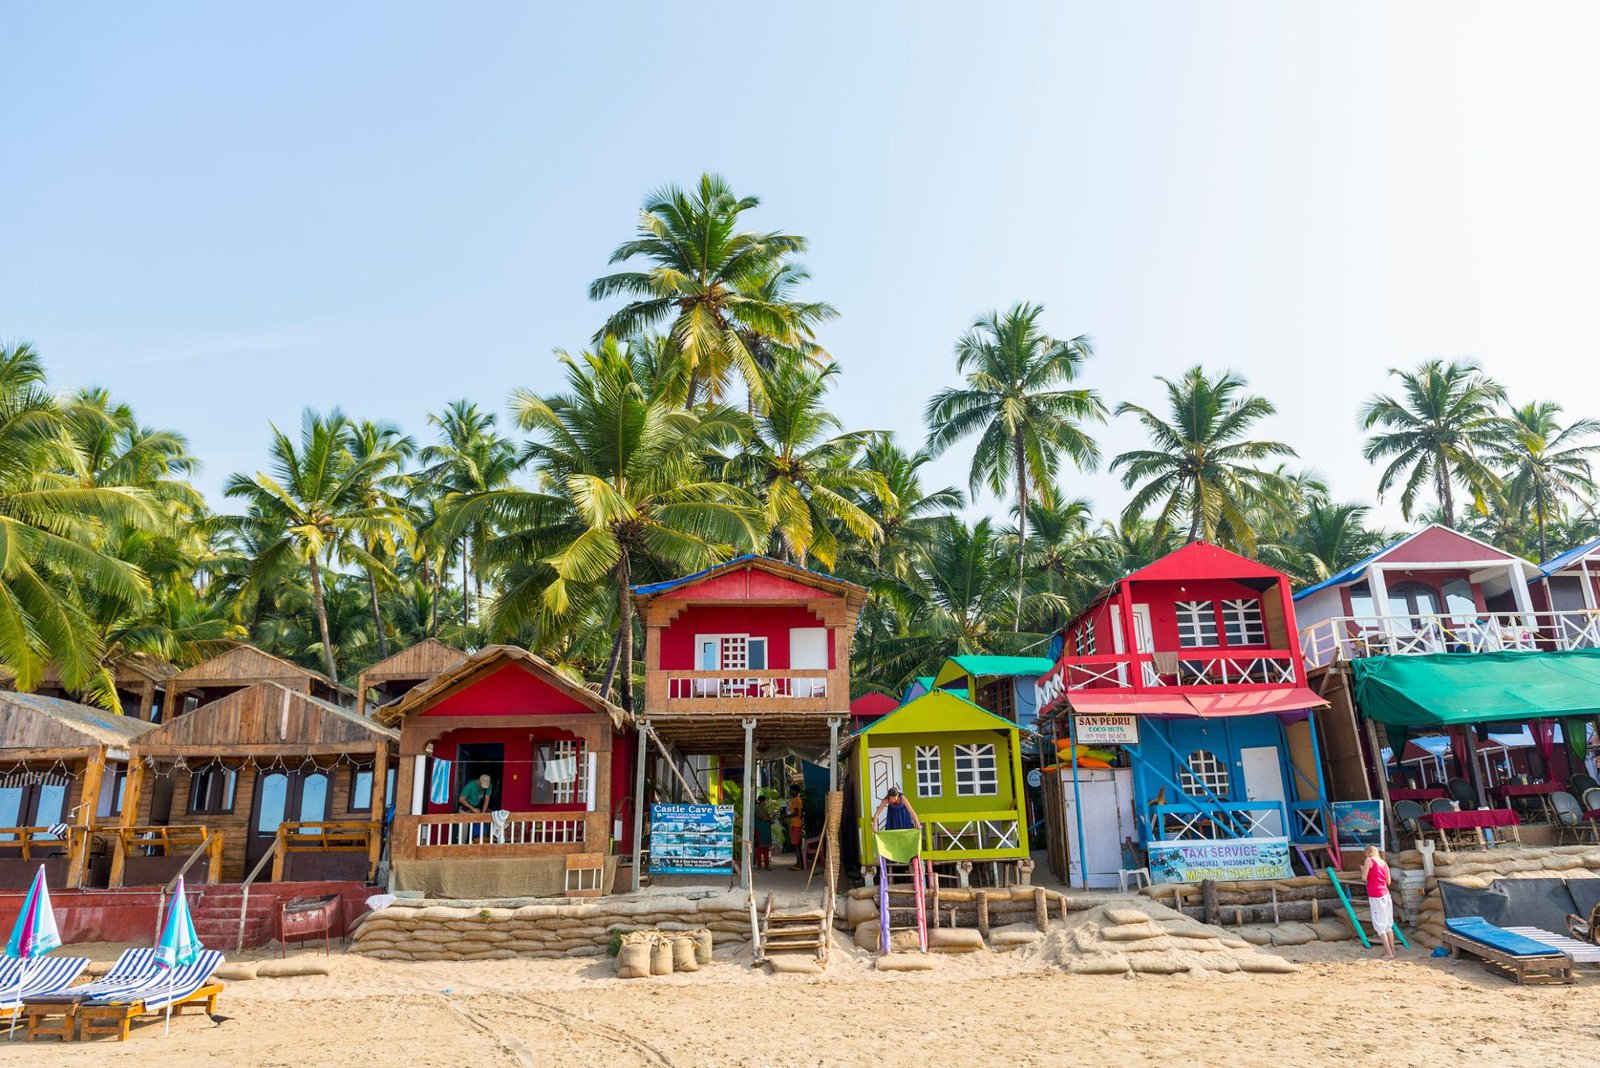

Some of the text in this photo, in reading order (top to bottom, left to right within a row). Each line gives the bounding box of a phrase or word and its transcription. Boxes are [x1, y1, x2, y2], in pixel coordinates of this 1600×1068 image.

[1079, 717, 1130, 725] SAN PEDRU
[654, 805, 713, 813] Castle Cave
[1182, 845, 1258, 858] TAXI SERVICE
[1186, 866, 1285, 881] MOTOR BIKE RENT
